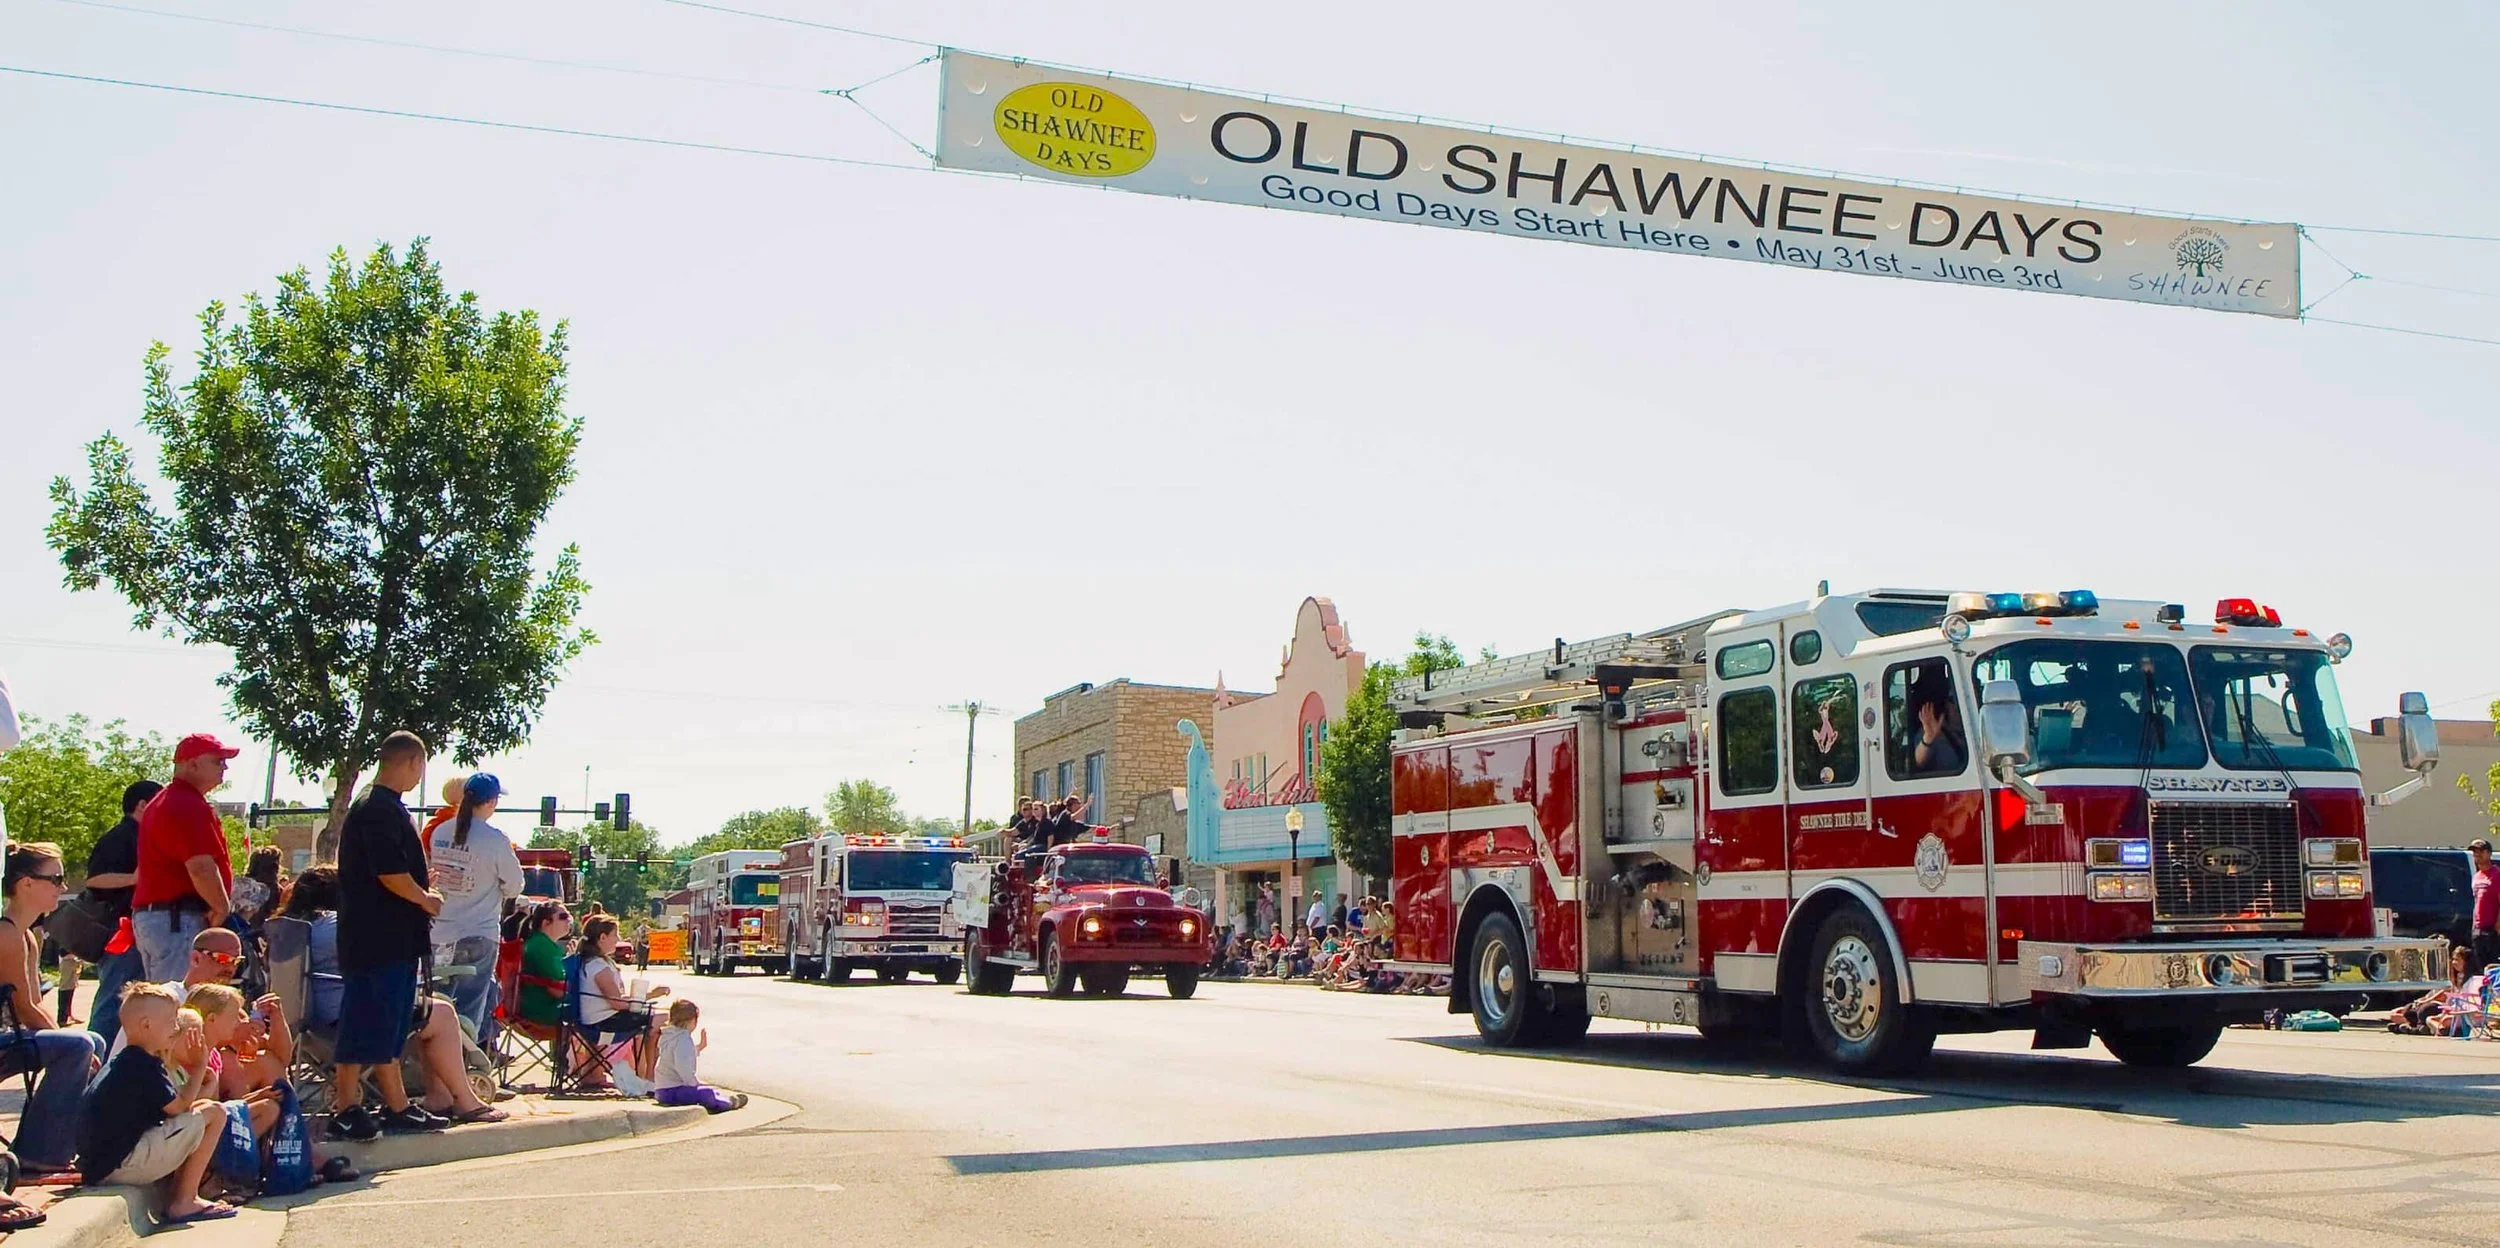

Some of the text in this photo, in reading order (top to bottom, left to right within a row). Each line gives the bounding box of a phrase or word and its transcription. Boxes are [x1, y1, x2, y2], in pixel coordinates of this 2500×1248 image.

[1051, 88, 1104, 113] OLD
[1003, 108, 1145, 151] SHAWNEE
[1036, 142, 1113, 171] DAYS
[1210, 111, 2103, 264] OLD SHAWNEE DAYS
[1261, 174, 1381, 211] Good
[1396, 192, 1500, 227] Days
[1513, 207, 1608, 239] Start
[1618, 220, 1710, 251] Here
[1755, 236, 1822, 269] May
[1833, 246, 1902, 274] 31st
[1932, 257, 2006, 284] June
[2012, 265, 2063, 290] 3rd
[2168, 229, 2189, 251] Good
[2212, 230, 2231, 252] Here
[2127, 272, 2272, 298] SHAWNEE
[2149, 777, 2288, 793] SHAWNEE
[1800, 813, 1833, 830] SHAWNEE
